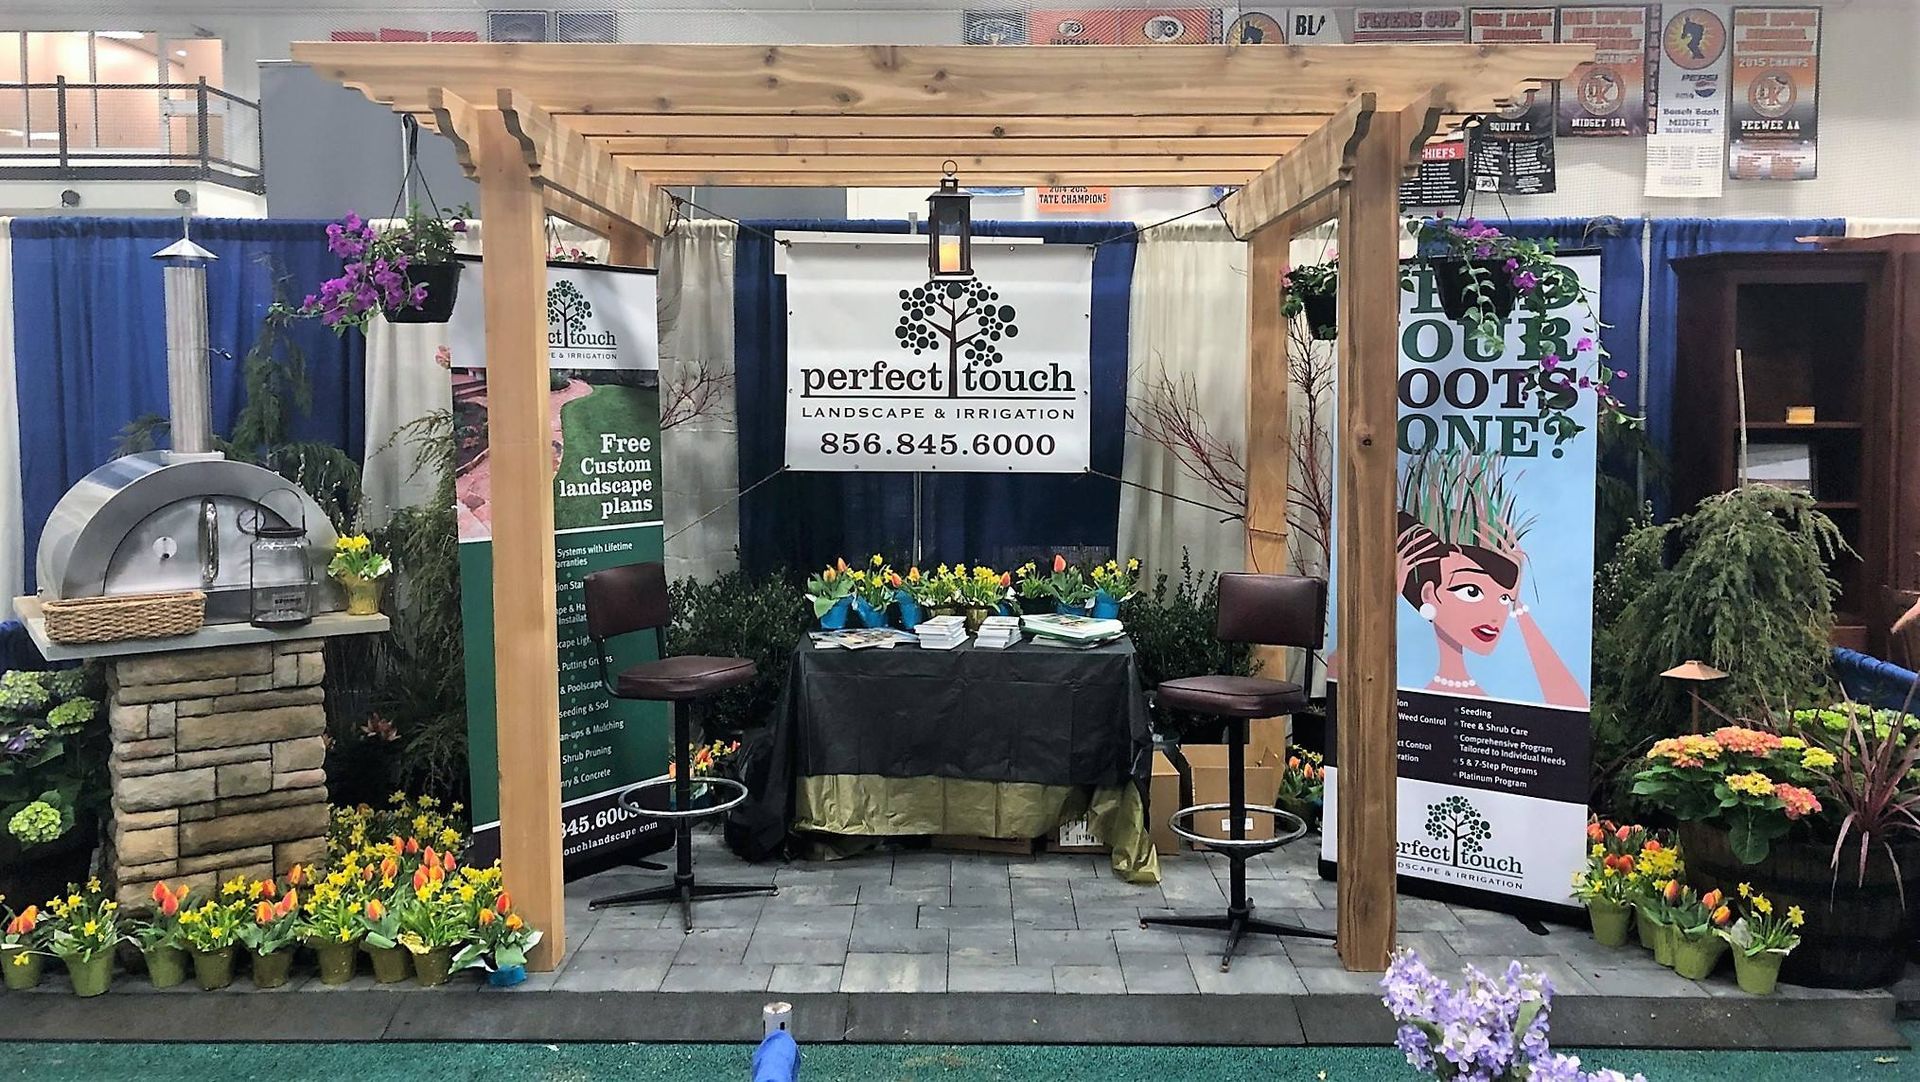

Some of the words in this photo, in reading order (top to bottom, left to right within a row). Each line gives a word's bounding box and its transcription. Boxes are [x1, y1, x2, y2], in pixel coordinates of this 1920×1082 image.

[1358, 11, 1422, 28] FLYERS
[1424, 10, 1461, 28] CUP
[1681, 74, 1718, 82] PEPSI
[1489, 122, 1522, 132] SQUIRT
[1524, 122, 1530, 131] A
[1571, 118, 1607, 128] MIDGET
[1668, 118, 1709, 126] MIDGET
[1741, 120, 1783, 130] PEEWEE
[1786, 120, 1800, 130] AA
[1039, 194, 1058, 204] TATE
[1061, 193, 1106, 204] CHAMPIONS
[569, 330, 616, 346] touch
[567, 352, 617, 360] IRRIGATION
[800, 360, 942, 397] perfect
[962, 362, 1076, 392] touch
[802, 407, 924, 419] LANDSCAPE
[934, 408, 946, 419] &
[956, 408, 1074, 420] IRRIGATION
[600, 433, 651, 454] Free
[820, 432, 1056, 456] 856.845.6000
[580, 456, 652, 476] Custom
[559, 477, 652, 498] landscape
[600, 497, 652, 520] plans
[557, 548, 587, 558] Systems
[588, 545, 603, 554] with
[604, 542, 632, 552] Lifetime
[556, 582, 568, 592] ion
[568, 604, 574, 612] &
[556, 639, 575, 650] cape
[562, 660, 587, 672] Putting
[560, 686, 566, 695] &
[566, 680, 603, 692] Poolscape
[588, 704, 594, 712] &
[596, 700, 609, 710] Sod
[1460, 706, 1492, 720] Seeding
[1398, 712, 1418, 722] Weed
[1420, 715, 1446, 726] Control
[586, 727, 591, 735] &
[592, 720, 624, 734] Mulching
[1460, 720, 1476, 730] Tree
[1477, 722, 1484, 731] &
[1486, 723, 1509, 734] Shrub
[1510, 726, 1529, 736] Care
[1405, 740, 1432, 750] Control
[1459, 734, 1519, 750] Comprehensive
[1520, 742, 1554, 754] Program
[562, 750, 584, 764] Shrub
[585, 745, 612, 758] Pruning
[1460, 744, 1490, 756] Tailored
[1491, 748, 1500, 756] to
[1501, 749, 1540, 763] Individual
[1540, 754, 1566, 767] Needs
[1459, 758, 1465, 766] 5
[1466, 758, 1473, 767] &
[1474, 759, 1500, 771] 7-Step
[1501, 763, 1538, 776] Programs
[573, 776, 579, 785] &
[580, 768, 611, 782] Concrete
[1458, 771, 1493, 783] Platinum
[1494, 775, 1528, 788] Program
[1460, 850, 1524, 874] touch
[1456, 872, 1524, 890] IRRIGATION
